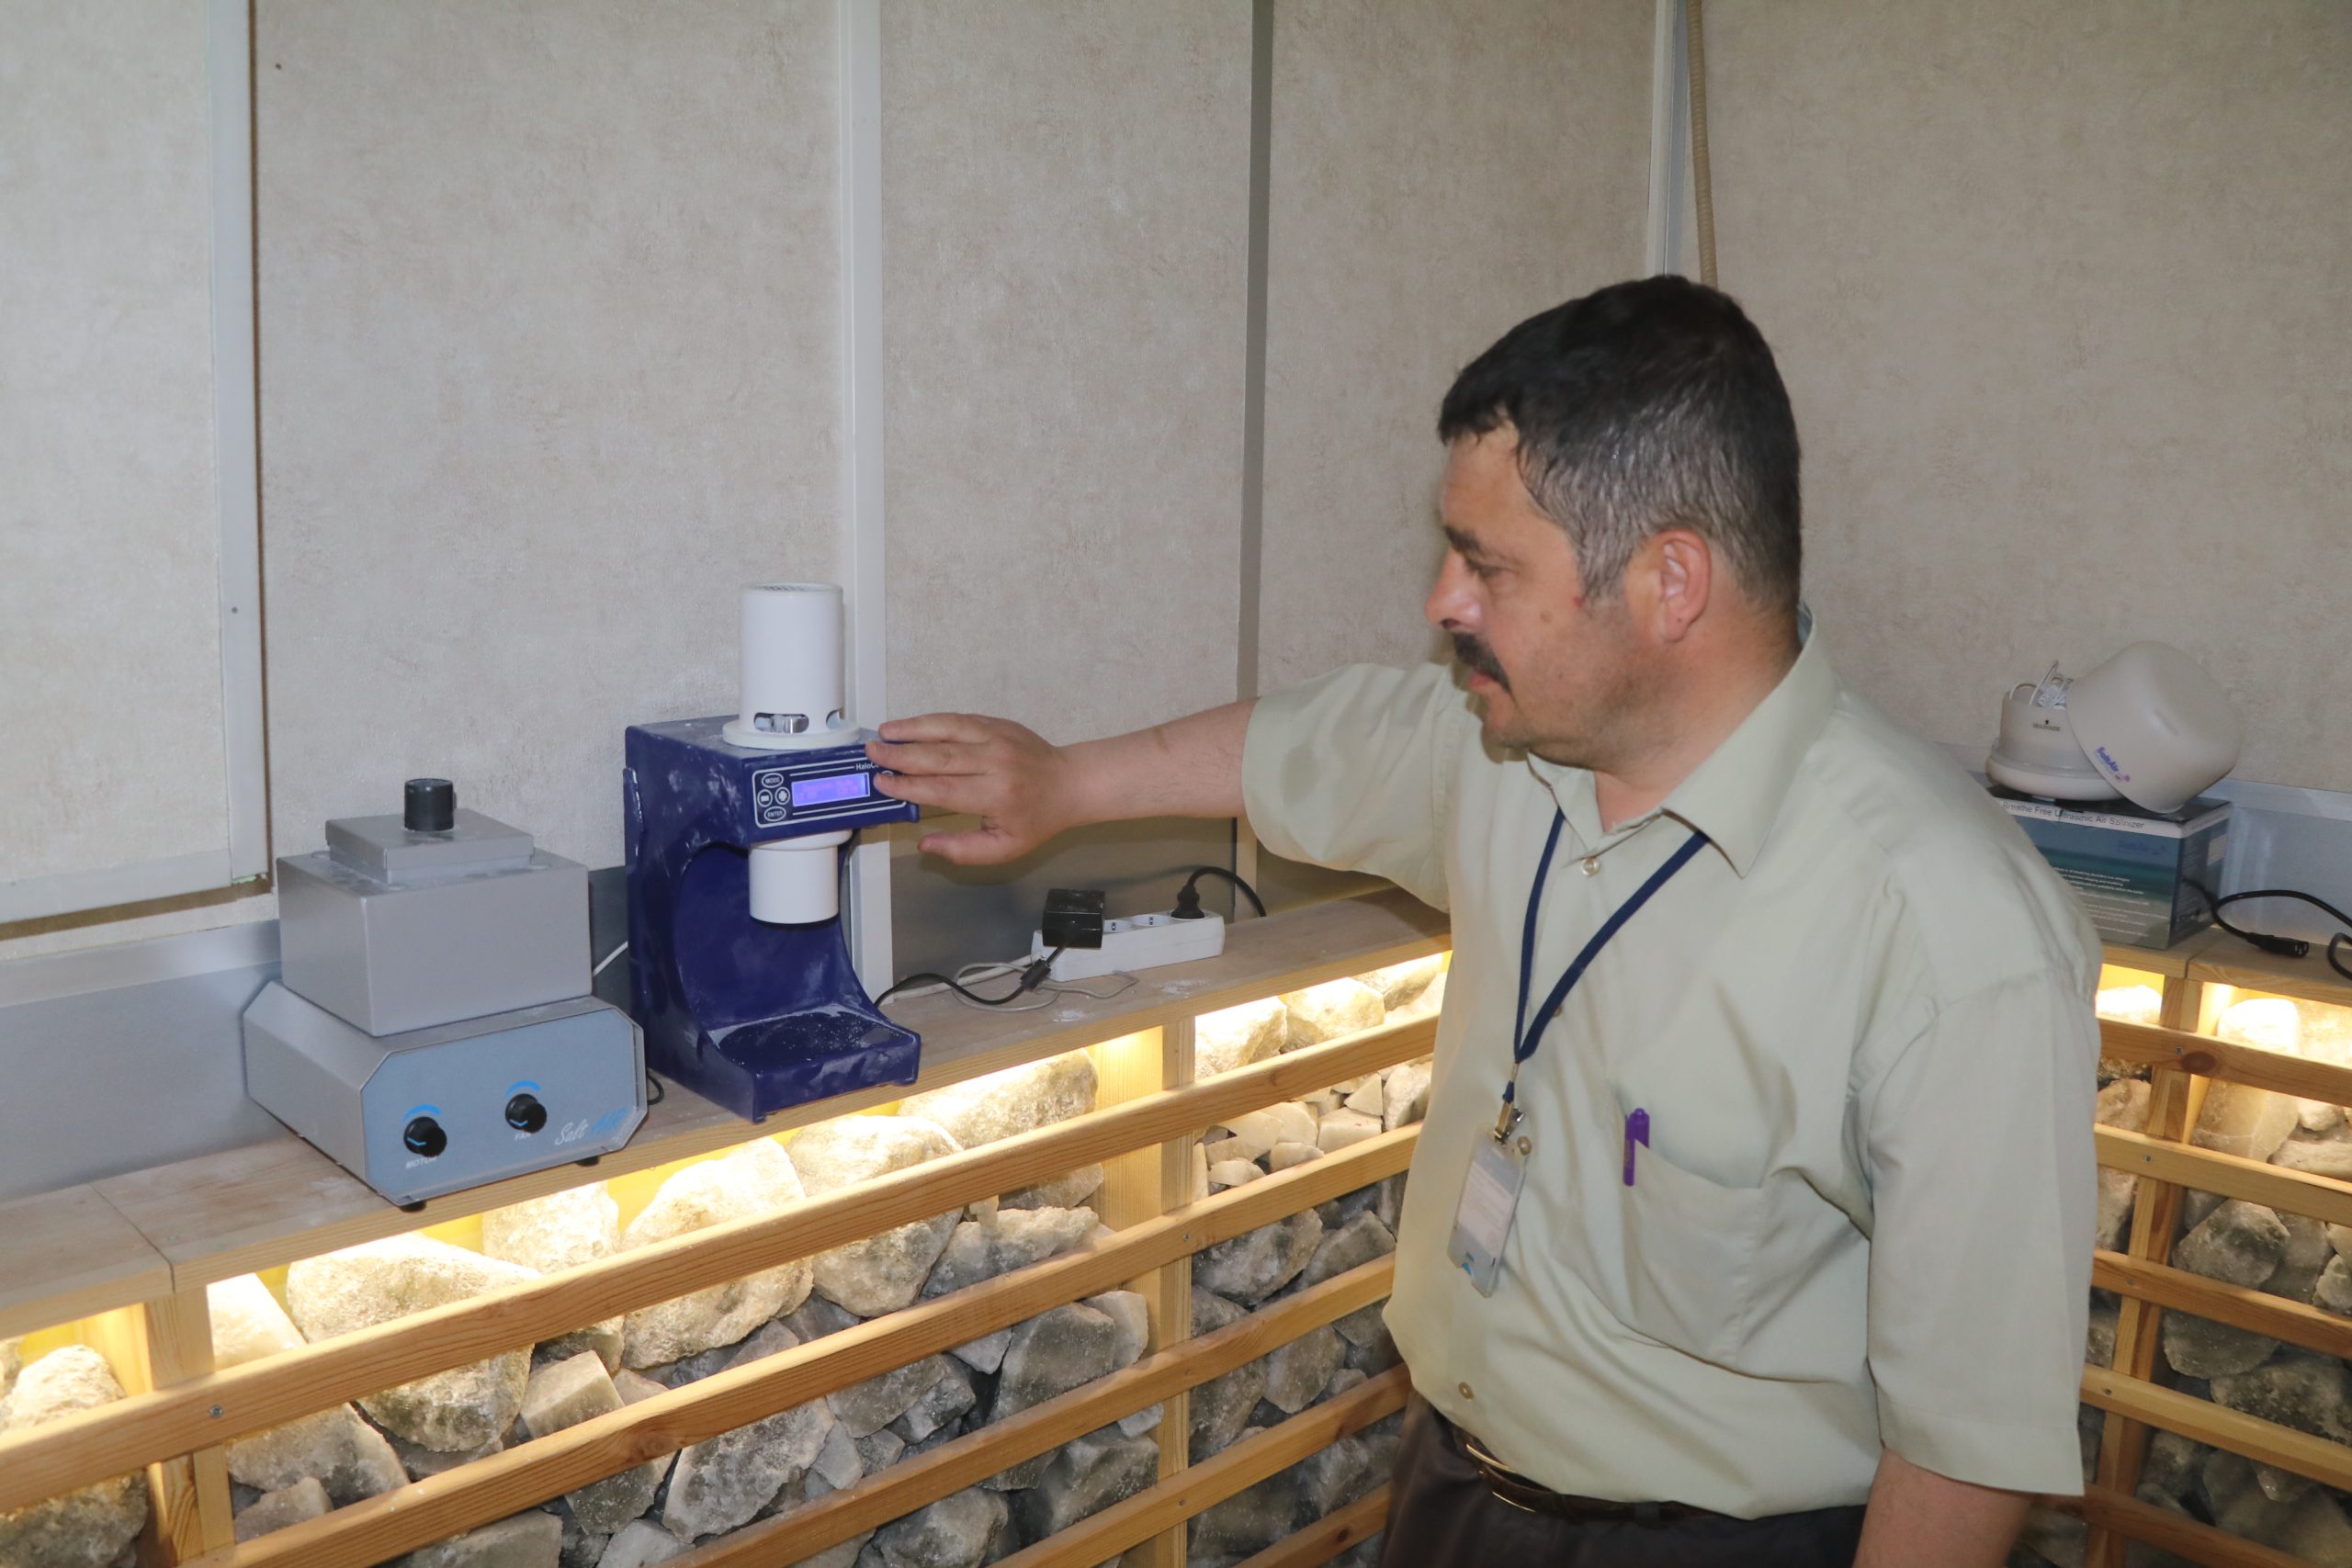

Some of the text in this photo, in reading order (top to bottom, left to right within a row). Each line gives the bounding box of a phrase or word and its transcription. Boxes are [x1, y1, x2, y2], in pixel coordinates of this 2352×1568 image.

[764, 776, 781, 784] MODE
[766, 810, 784, 818] ENTER
[2003, 801, 2032, 813] Breathe
[2034, 805, 2052, 816] Free
[2096, 815, 2108, 824] Air
[2109, 816, 2145, 829] Salinizer
[514, 1132, 532, 1141] FAN
[554, 1118, 589, 1145] Salt
[405, 1156, 438, 1169] MOTOR
